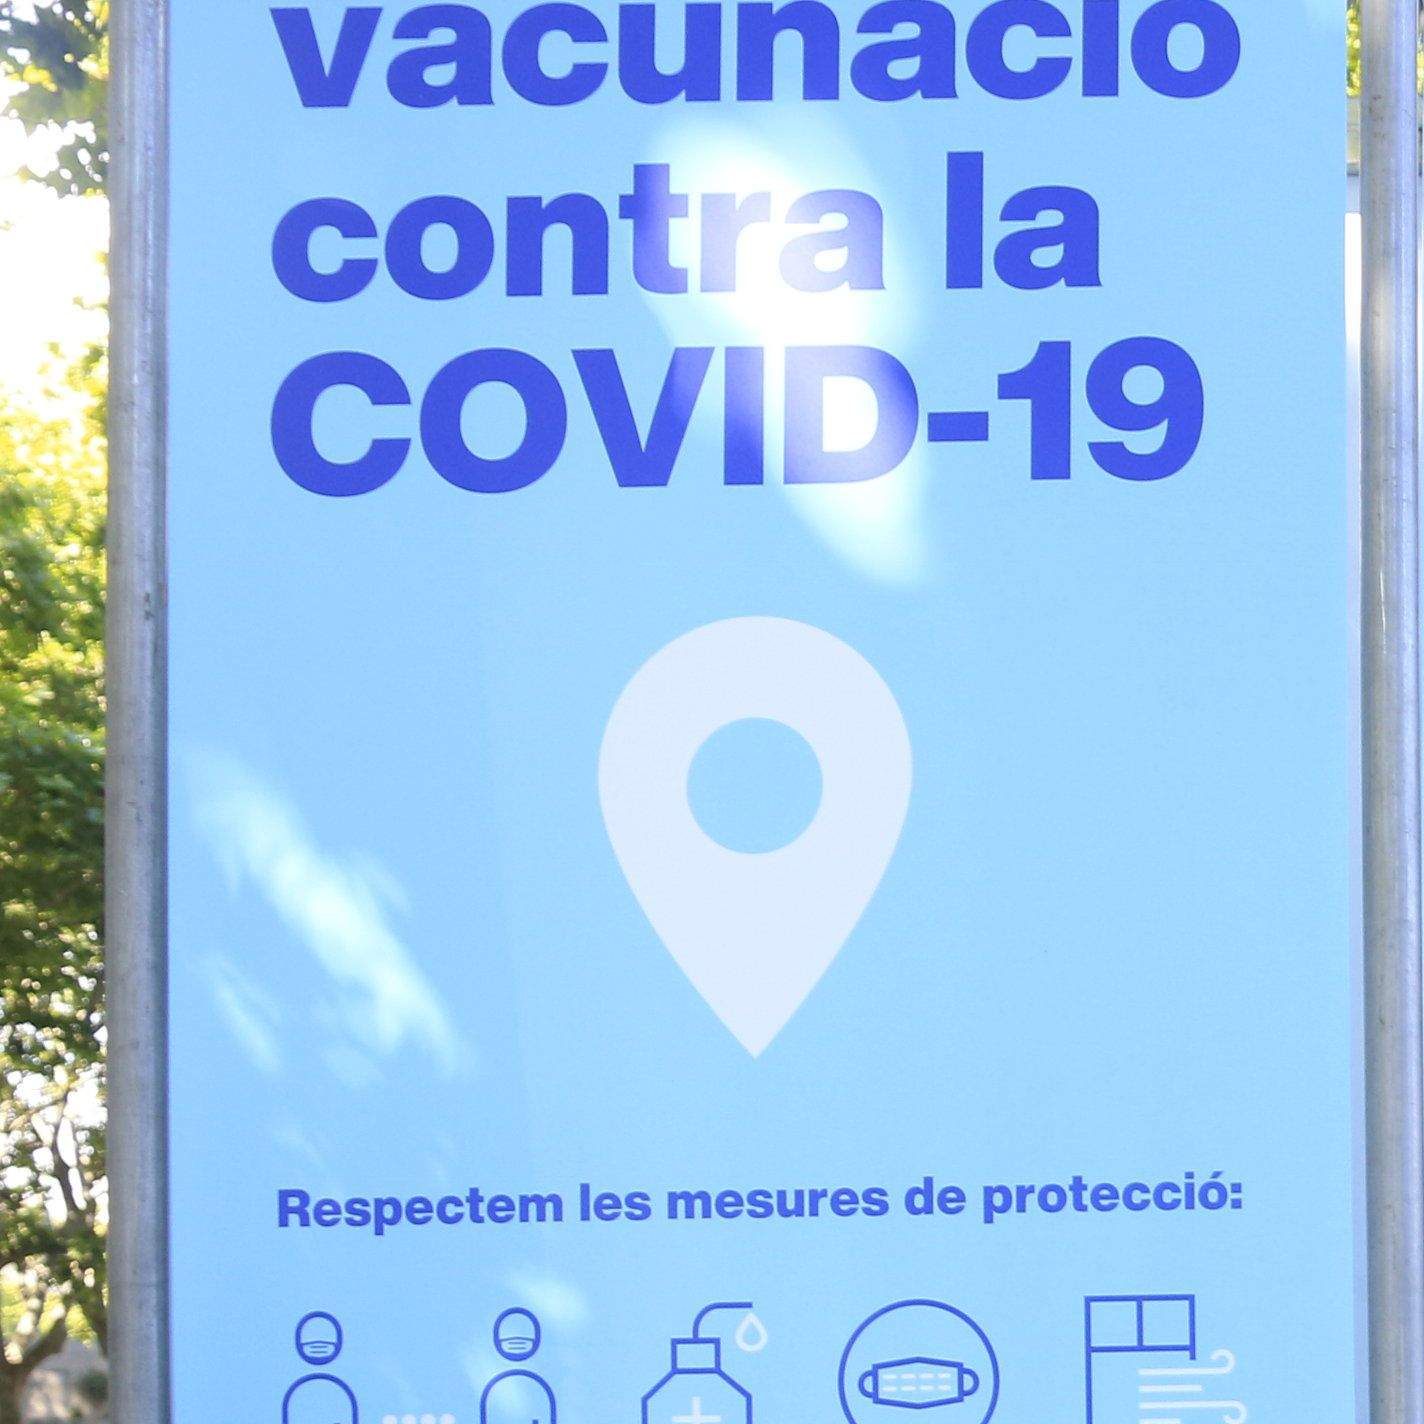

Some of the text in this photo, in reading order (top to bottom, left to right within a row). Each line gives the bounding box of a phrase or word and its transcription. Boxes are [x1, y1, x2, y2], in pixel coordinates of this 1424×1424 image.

[271, 151, 1103, 303] contra la
[270, 337, 1205, 498] COVID-19
[278, 1171, 1243, 1236] Respectem les mesures de protecció:
